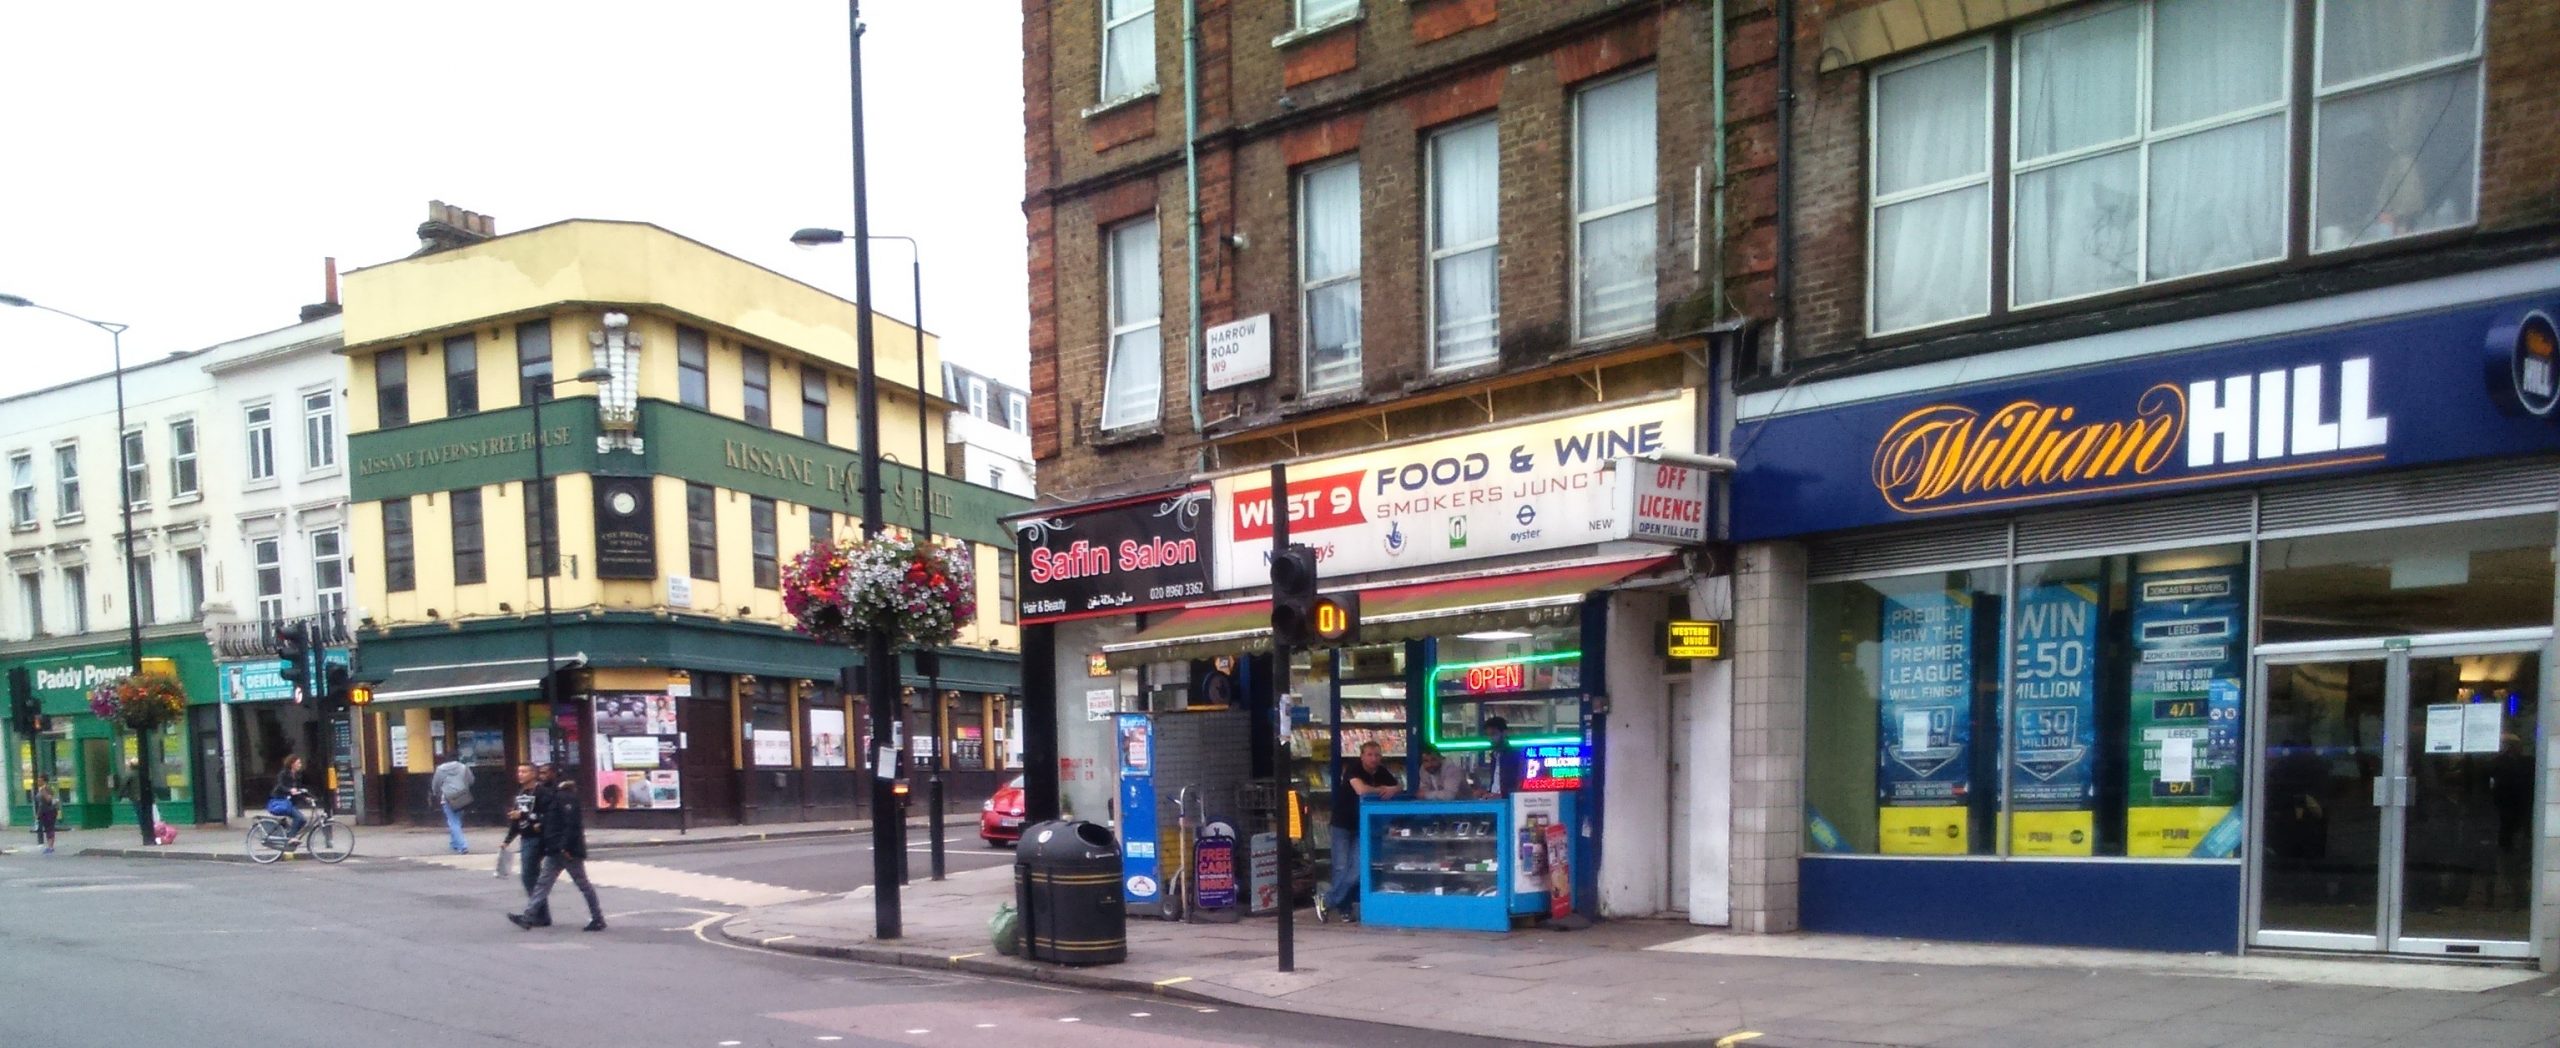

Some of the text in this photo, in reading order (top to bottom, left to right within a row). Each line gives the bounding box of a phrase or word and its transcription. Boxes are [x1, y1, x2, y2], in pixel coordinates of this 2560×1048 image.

[1211, 322, 1256, 344] HARROW
[1211, 342, 1240, 360] ROAD
[1212, 359, 1227, 374] W9
[1872, 356, 2388, 505] William HILL
[358, 450, 416, 476] KISSANE
[418, 441, 480, 467] TAVERNS
[482, 433, 519, 456] FREE
[724, 438, 814, 487] KISSANE
[1376, 420, 1664, 496] FOOD & WINE
[1656, 465, 1688, 490] OFF
[1329, 486, 1353, 515] 9
[1377, 470, 1615, 519] SMOKERS JUNCT
[1639, 494, 1702, 523] LICENCE
[1510, 527, 1542, 543] oyster
[1638, 522, 1699, 538] OPEN TILL LATE
[1030, 536, 1197, 584] Safin Salon
[1150, 582, 1204, 600] 020 8960 3362
[2194, 583, 2225, 592] ROVERS
[1023, 599, 1067, 614] Hair & Beauty
[1891, 604, 1964, 625] PREDICT
[1318, 604, 1346, 632] 01
[2016, 601, 2086, 640] WIN
[1671, 627, 1709, 636] WESTERN
[1890, 624, 1963, 644] HOW THE
[2167, 624, 2200, 636] LEEDS
[1683, 636, 1709, 645] UNION
[1890, 643, 1963, 664] PREMIER
[37, 664, 134, 691] Paddy Power
[1468, 665, 1520, 690] OPEN
[1889, 663, 1963, 685] LEAGUE
[2156, 670, 2165, 681] TO
[2167, 670, 2184, 681] WIN
[2193, 667, 2213, 680] BOTH
[1889, 685, 1963, 700] WILL FINISH
[2153, 681, 2179, 693] TEAMS
[2180, 680, 2190, 692] TO
[2169, 702, 2196, 718] 4/1
[2021, 736, 2068, 748] MILLION
[2167, 727, 2199, 739] LEEDS
[2162, 829, 2189, 840] FUN
[1199, 847, 1231, 861] FREE
[1199, 860, 1232, 874] CASH
[1200, 878, 1234, 891] INSIDE
